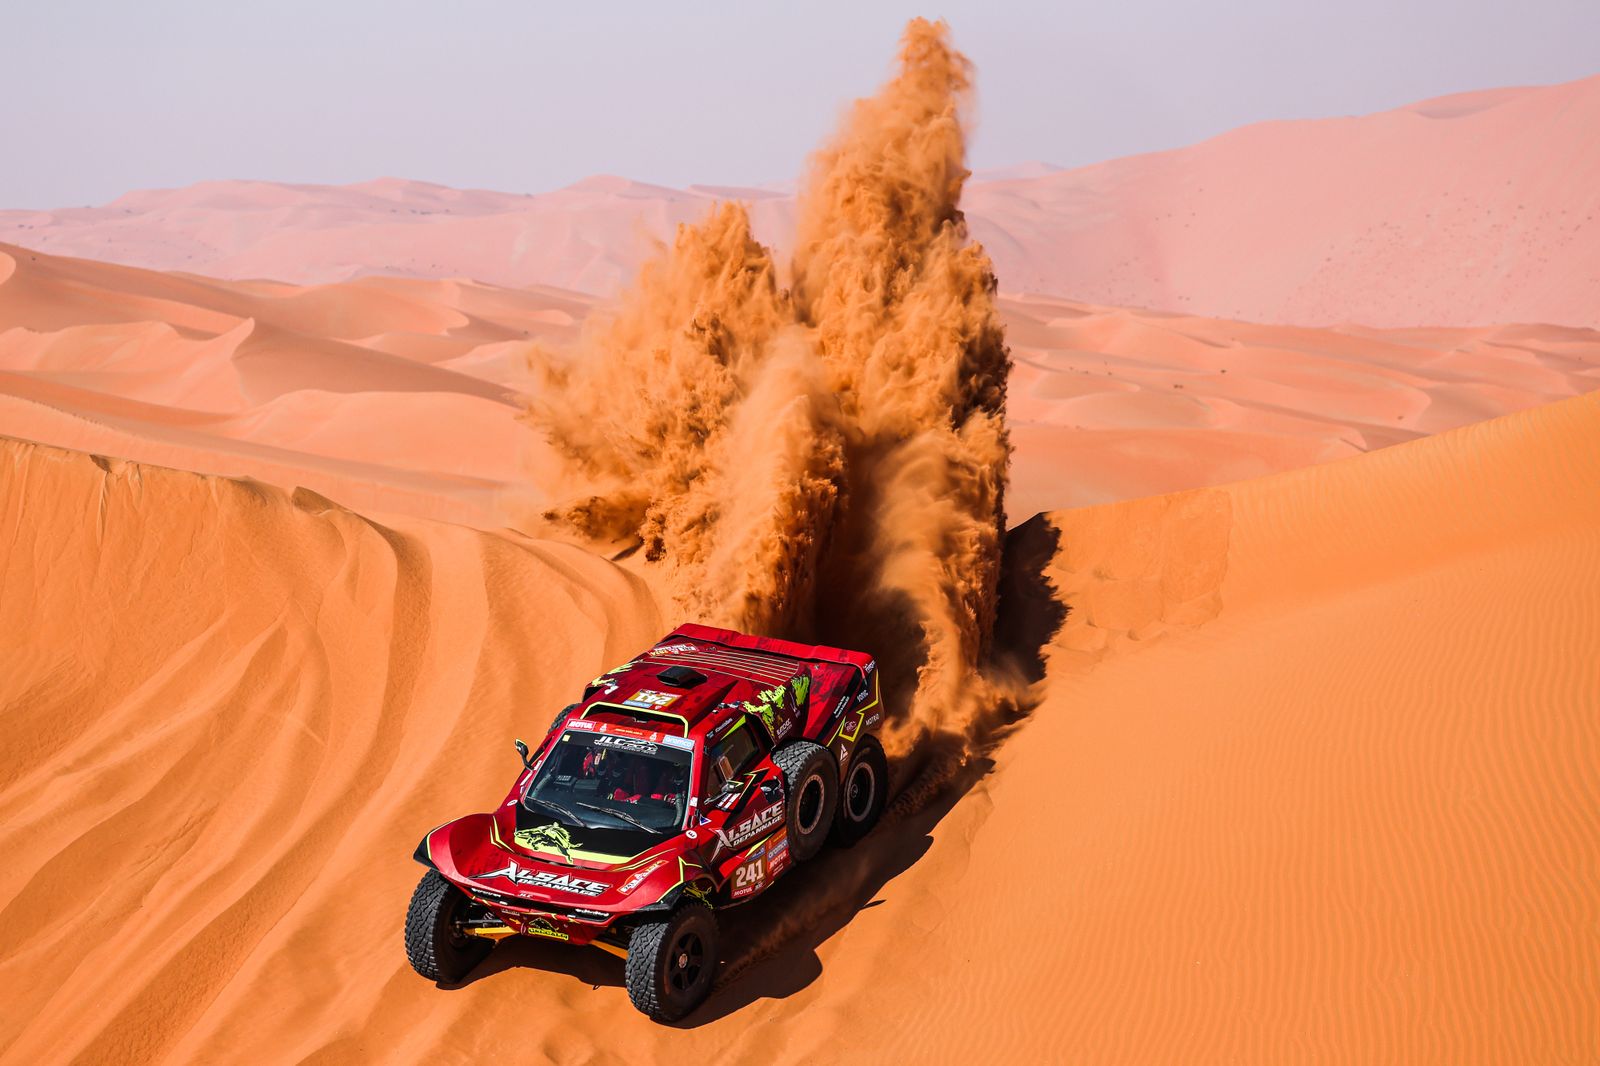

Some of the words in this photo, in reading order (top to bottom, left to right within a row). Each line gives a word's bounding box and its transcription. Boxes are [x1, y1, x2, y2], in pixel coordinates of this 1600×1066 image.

[568, 721, 593, 729] MOTUL
[711, 802, 783, 862] ALSACE
[733, 814, 783, 846] DEPANNAGE
[467, 859, 612, 893] ALSACE
[735, 859, 764, 887] 241
[518, 879, 600, 897] DEPANNAGE
[734, 888, 753, 897] MOTUL
